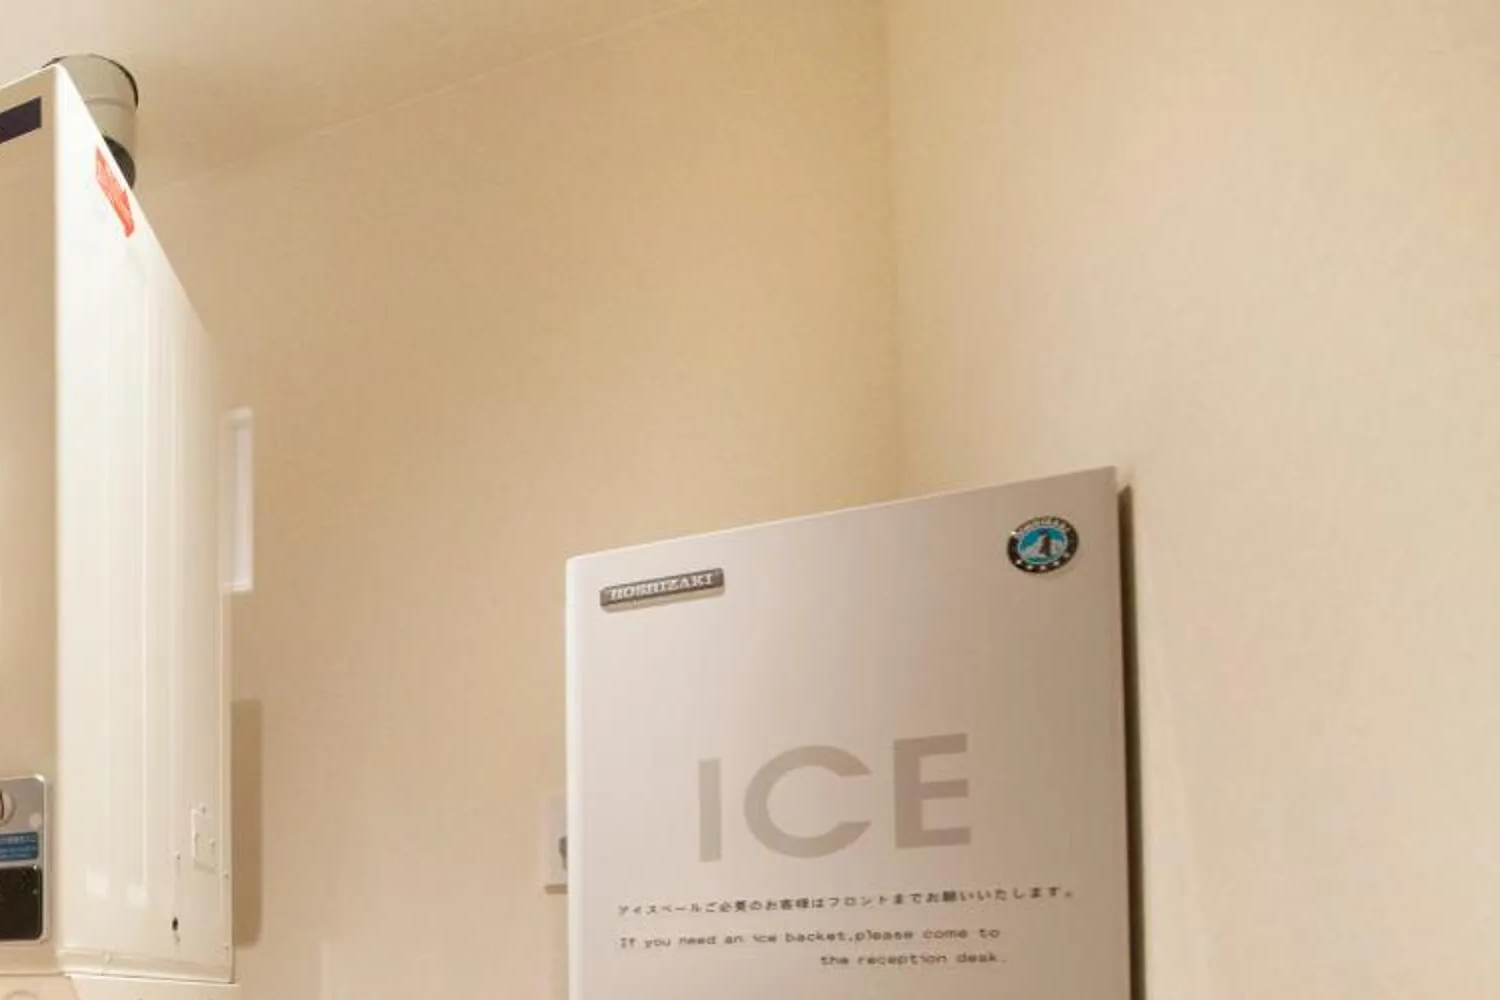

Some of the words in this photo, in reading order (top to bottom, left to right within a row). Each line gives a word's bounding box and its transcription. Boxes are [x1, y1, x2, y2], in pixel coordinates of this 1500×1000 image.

[610, 572, 714, 600] HOSHIZAKI
[697, 732, 973, 864] ICE
[619, 937, 636, 949] If
[644, 937, 672, 949] you
[678, 934, 717, 946] need
[723, 935, 744, 945] an
[921, 928, 969, 940] come
[978, 927, 1001, 939] to
[820, 955, 850, 966] the
[857, 952, 948, 966] reception
